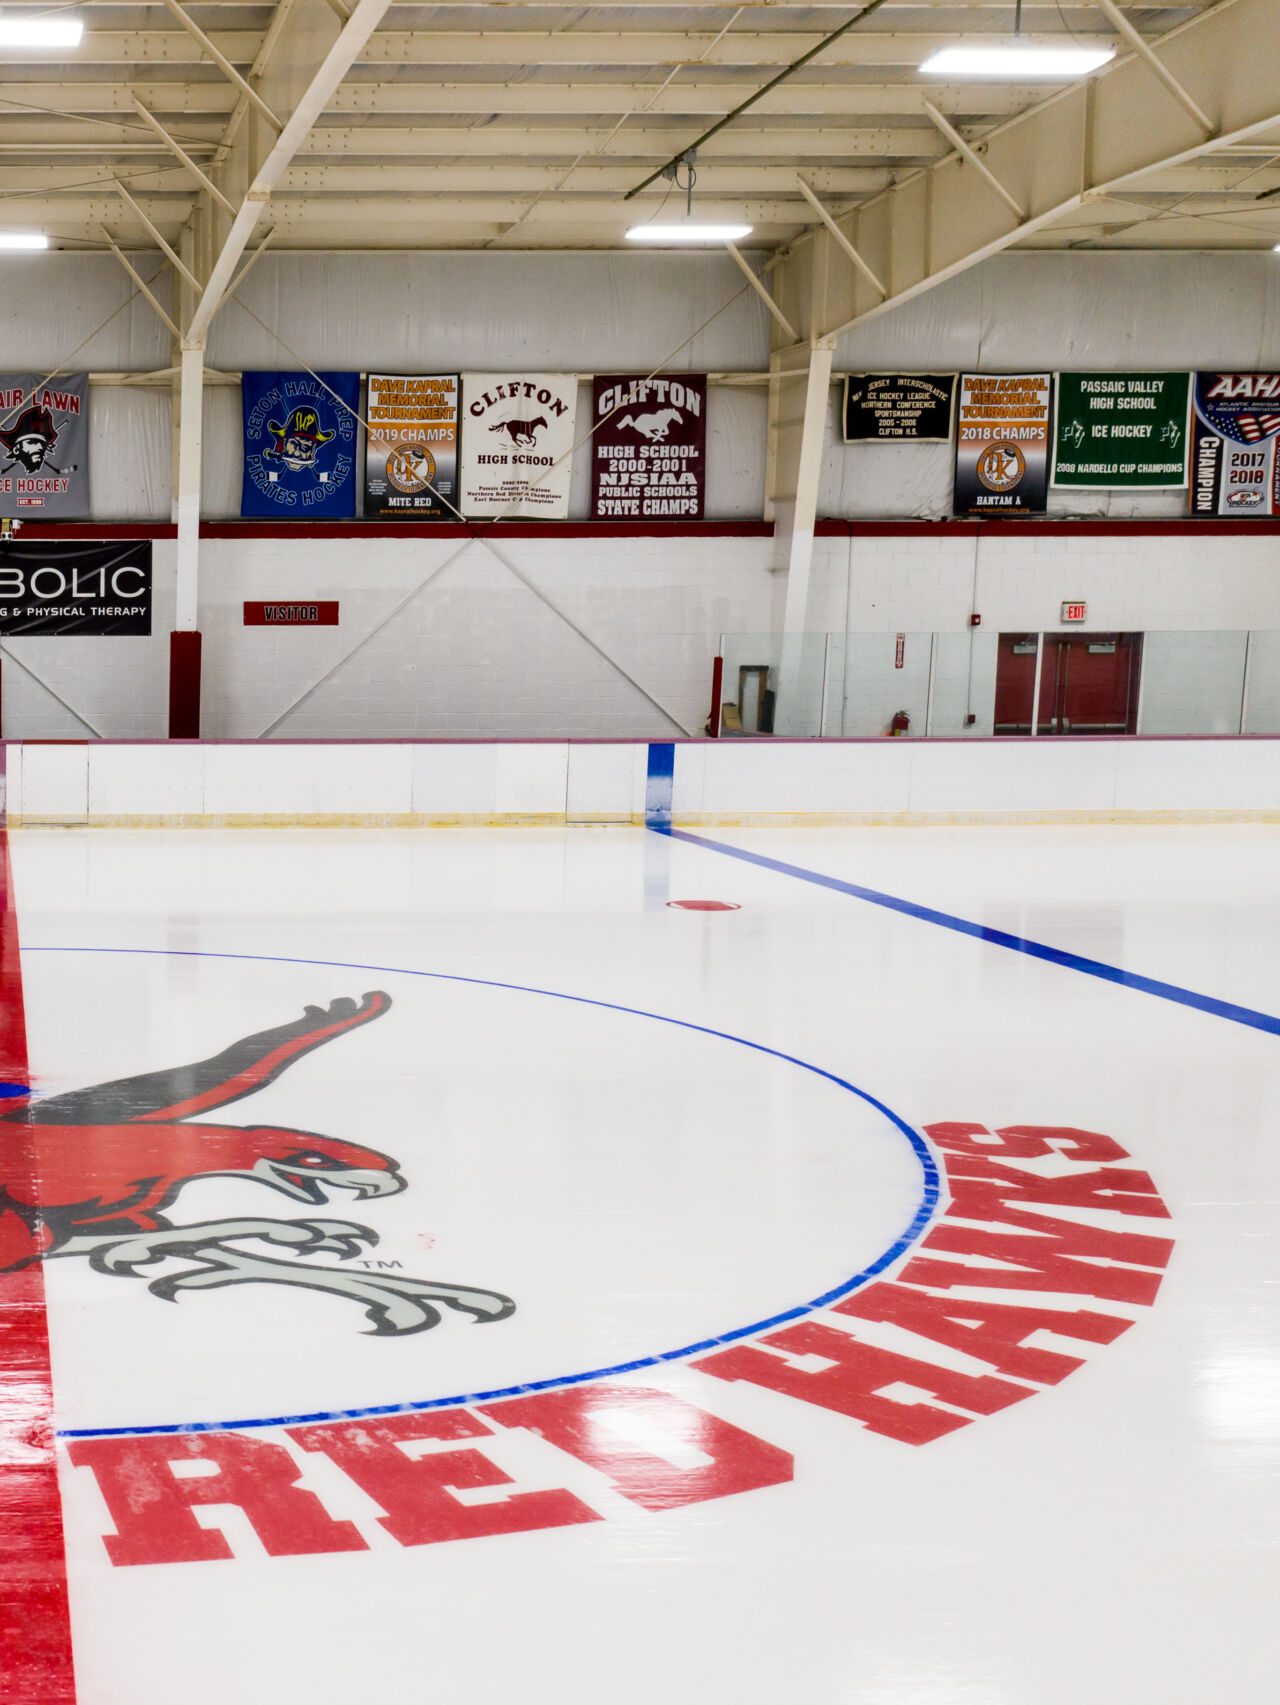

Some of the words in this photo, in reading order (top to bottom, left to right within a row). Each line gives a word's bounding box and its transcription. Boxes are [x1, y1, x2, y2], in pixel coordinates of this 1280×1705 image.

[371, 379, 405, 392] DAVE
[406, 380, 455, 393] KAPRAL
[868, 379, 890, 391] JERSEY
[897, 378, 948, 401] INTERSCHOLASTIC
[964, 378, 998, 391] DAVE
[998, 379, 1048, 391] KAPRAL
[1081, 381, 1125, 393] PASSAIC
[1128, 381, 1164, 393] VALLEY
[32, 388, 80, 415] LAWN
[378, 394, 448, 406] MEMORIAL
[470, 381, 569, 418] CLIFTON
[598, 379, 701, 417] CLIFTON
[971, 392, 1040, 405] MEMORIAL
[1090, 398, 1114, 409] HIGH
[1117, 397, 1157, 409] SCHOOL
[247, 387, 282, 439] SETON
[285, 381, 326, 400] HALL
[328, 397, 353, 441] PREP
[370, 406, 455, 420] TOURNAMENT
[962, 406, 1047, 418] TOURNAMENT
[370, 428, 398, 441] 2019
[400, 428, 454, 441] CHAMPS
[961, 427, 990, 440] 2018
[993, 427, 1045, 440] CHAMPS
[1091, 425, 1108, 438] ICE
[1111, 425, 1152, 438] HOCKEY
[598, 446, 634, 458] HIGH
[640, 445, 699, 458] SCHOOL
[478, 454, 508, 465] HIGH
[512, 455, 555, 466] SCHOOL
[609, 459, 686, 472] 2000-2001
[1231, 453, 1265, 467] 2017
[1057, 463, 1076, 473] 2008
[1078, 463, 1118, 473] NARDELLO
[1120, 463, 1136, 473] CUP
[1137, 463, 1183, 473] CHAMPIONS
[1197, 436, 1220, 510] CHAMPION
[247, 455, 297, 506] PIRATES
[302, 454, 351, 506] HOCKEY
[600, 473, 697, 485] NJSIAA
[1230, 470, 1264, 484] 2018
[17, 478, 69, 492] HOCKEY
[599, 487, 640, 497] PUBLIC
[644, 486, 697, 496] SCHOOLS
[388, 498, 411, 506] MITE
[414, 498, 431, 506] RED
[597, 500, 639, 515] STATE
[643, 499, 698, 515] CHAMPS
[977, 496, 1013, 505] BANTAM
[1015, 496, 1021, 505] A
[13, 607, 21, 616] &
[27, 607, 85, 616] PHYSICAL
[90, 607, 146, 616] THERAPY
[264, 606, 318, 621] VISITOR
[1068, 606, 1085, 619] EXIT
[356, 1260, 404, 1268] TM
[65, 1384, 795, 1568] RED
[685, 1121, 1177, 1447] HAWKS
